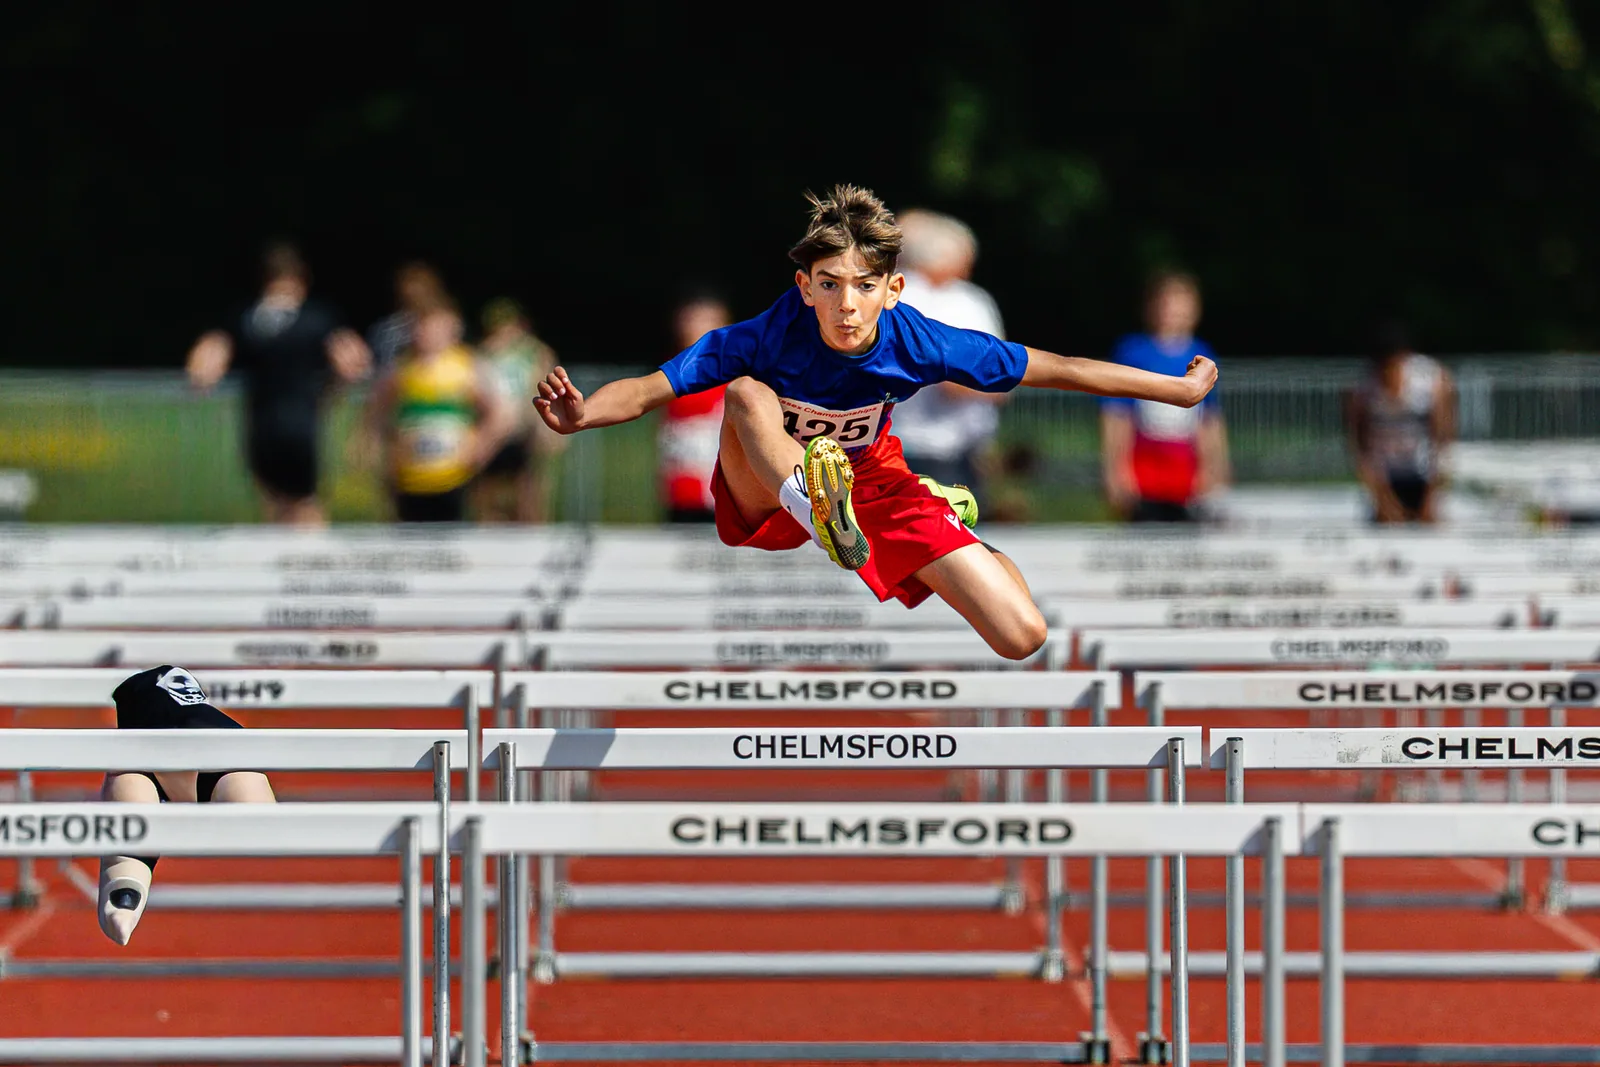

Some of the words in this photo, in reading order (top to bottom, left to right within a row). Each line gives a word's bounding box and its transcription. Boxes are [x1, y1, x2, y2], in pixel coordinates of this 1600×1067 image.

[778, 398, 802, 410] ssex
[804, 406, 877, 419] Championships
[783, 410, 871, 443] 425
[664, 680, 958, 701] CHELMSFORD
[1298, 681, 1599, 702] CHELMSFORD
[733, 735, 957, 759] CHELMSFORD
[1401, 737, 1600, 760] CHELMS
[669, 815, 1075, 845] CHELMSFORD
